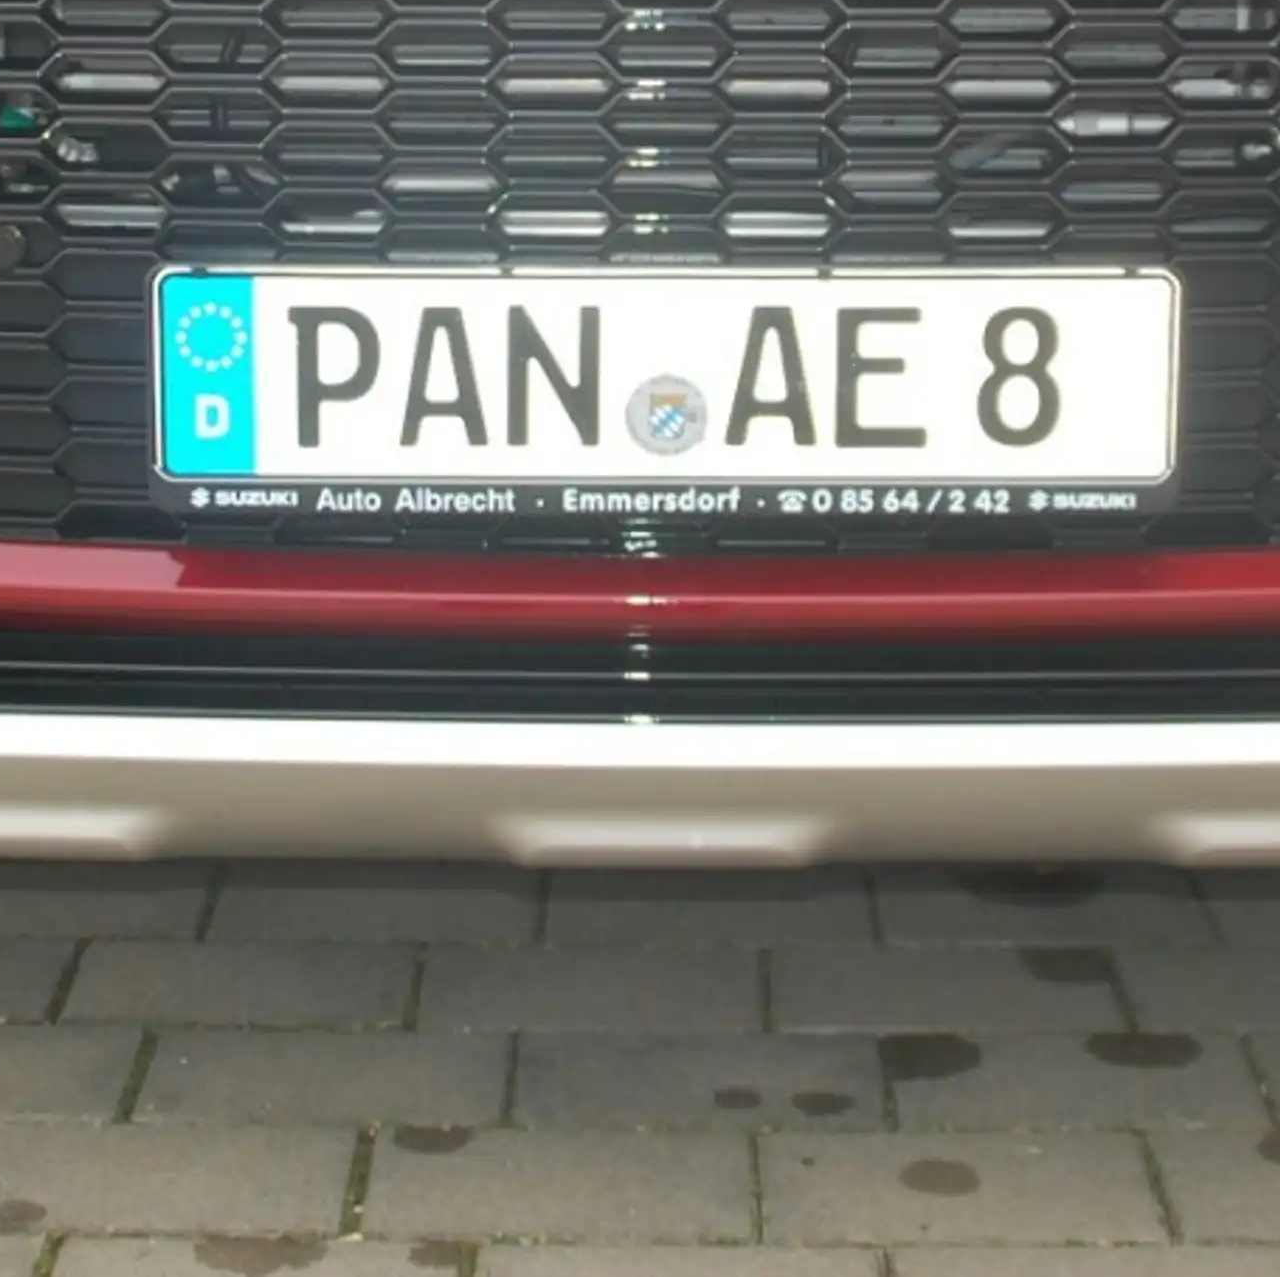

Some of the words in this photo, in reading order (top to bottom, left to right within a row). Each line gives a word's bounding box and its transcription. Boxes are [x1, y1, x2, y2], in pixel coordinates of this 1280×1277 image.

[287, 305, 600, 448] PAN
[724, 306, 928, 448] AE
[976, 307, 1061, 448] 8
[195, 394, 230, 439] D
[214, 490, 299, 507] SUZUKI
[315, 487, 382, 512] Auto
[394, 487, 516, 513] Albrecht
[561, 487, 742, 513] Emmersdorf
[839, 488, 875, 514] 85
[1051, 492, 1137, 510] SUZUKI
